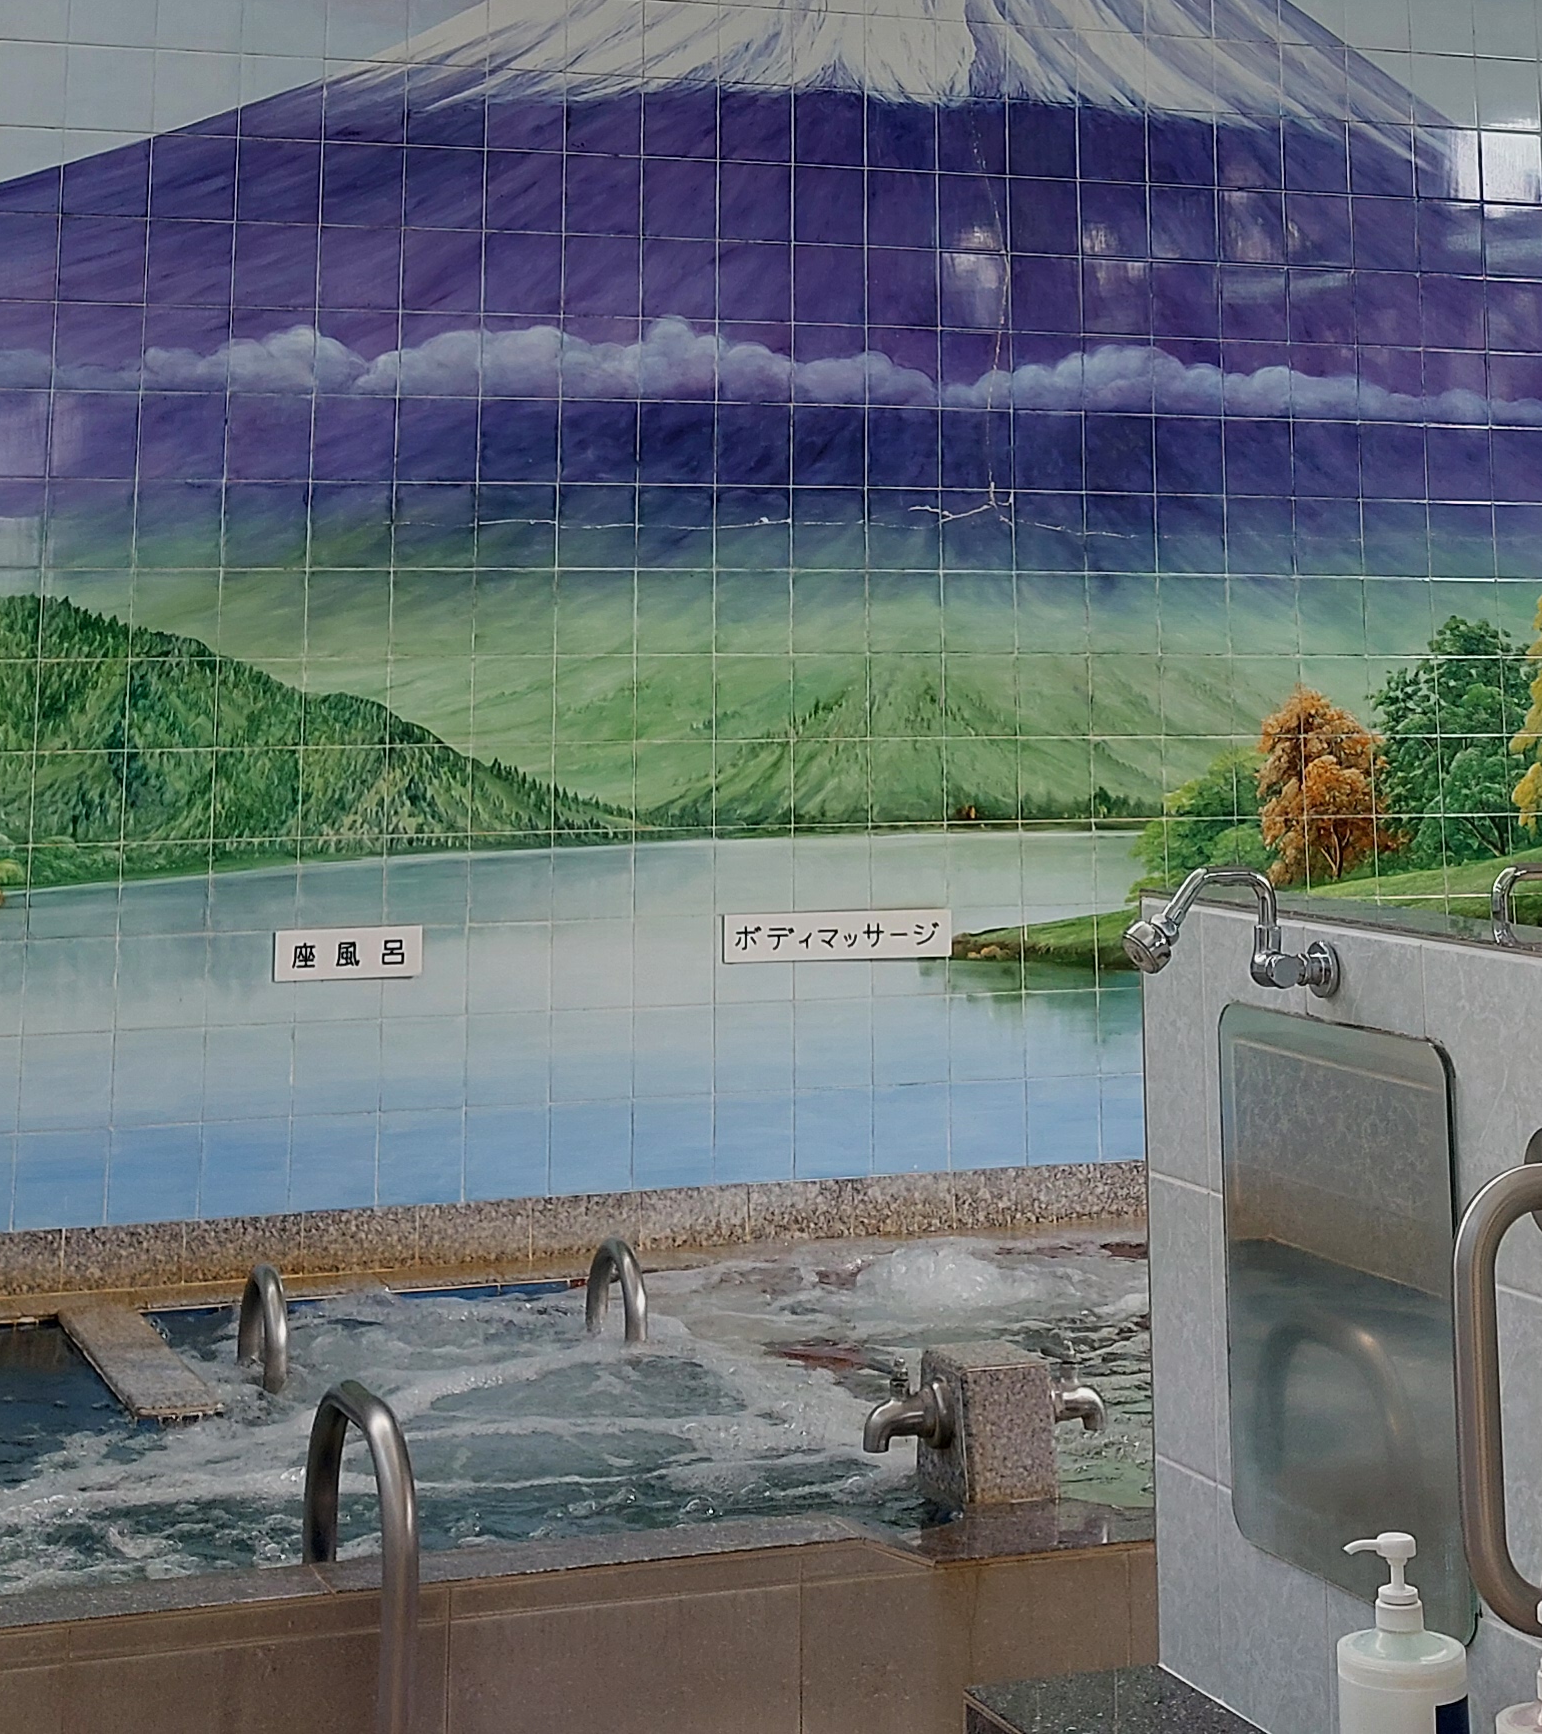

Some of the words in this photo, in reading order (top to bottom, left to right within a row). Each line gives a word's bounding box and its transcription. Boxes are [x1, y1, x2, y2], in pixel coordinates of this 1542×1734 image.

[735, 922, 940, 951] ボディマッサージ
[292, 939, 405, 969] 座風呂
